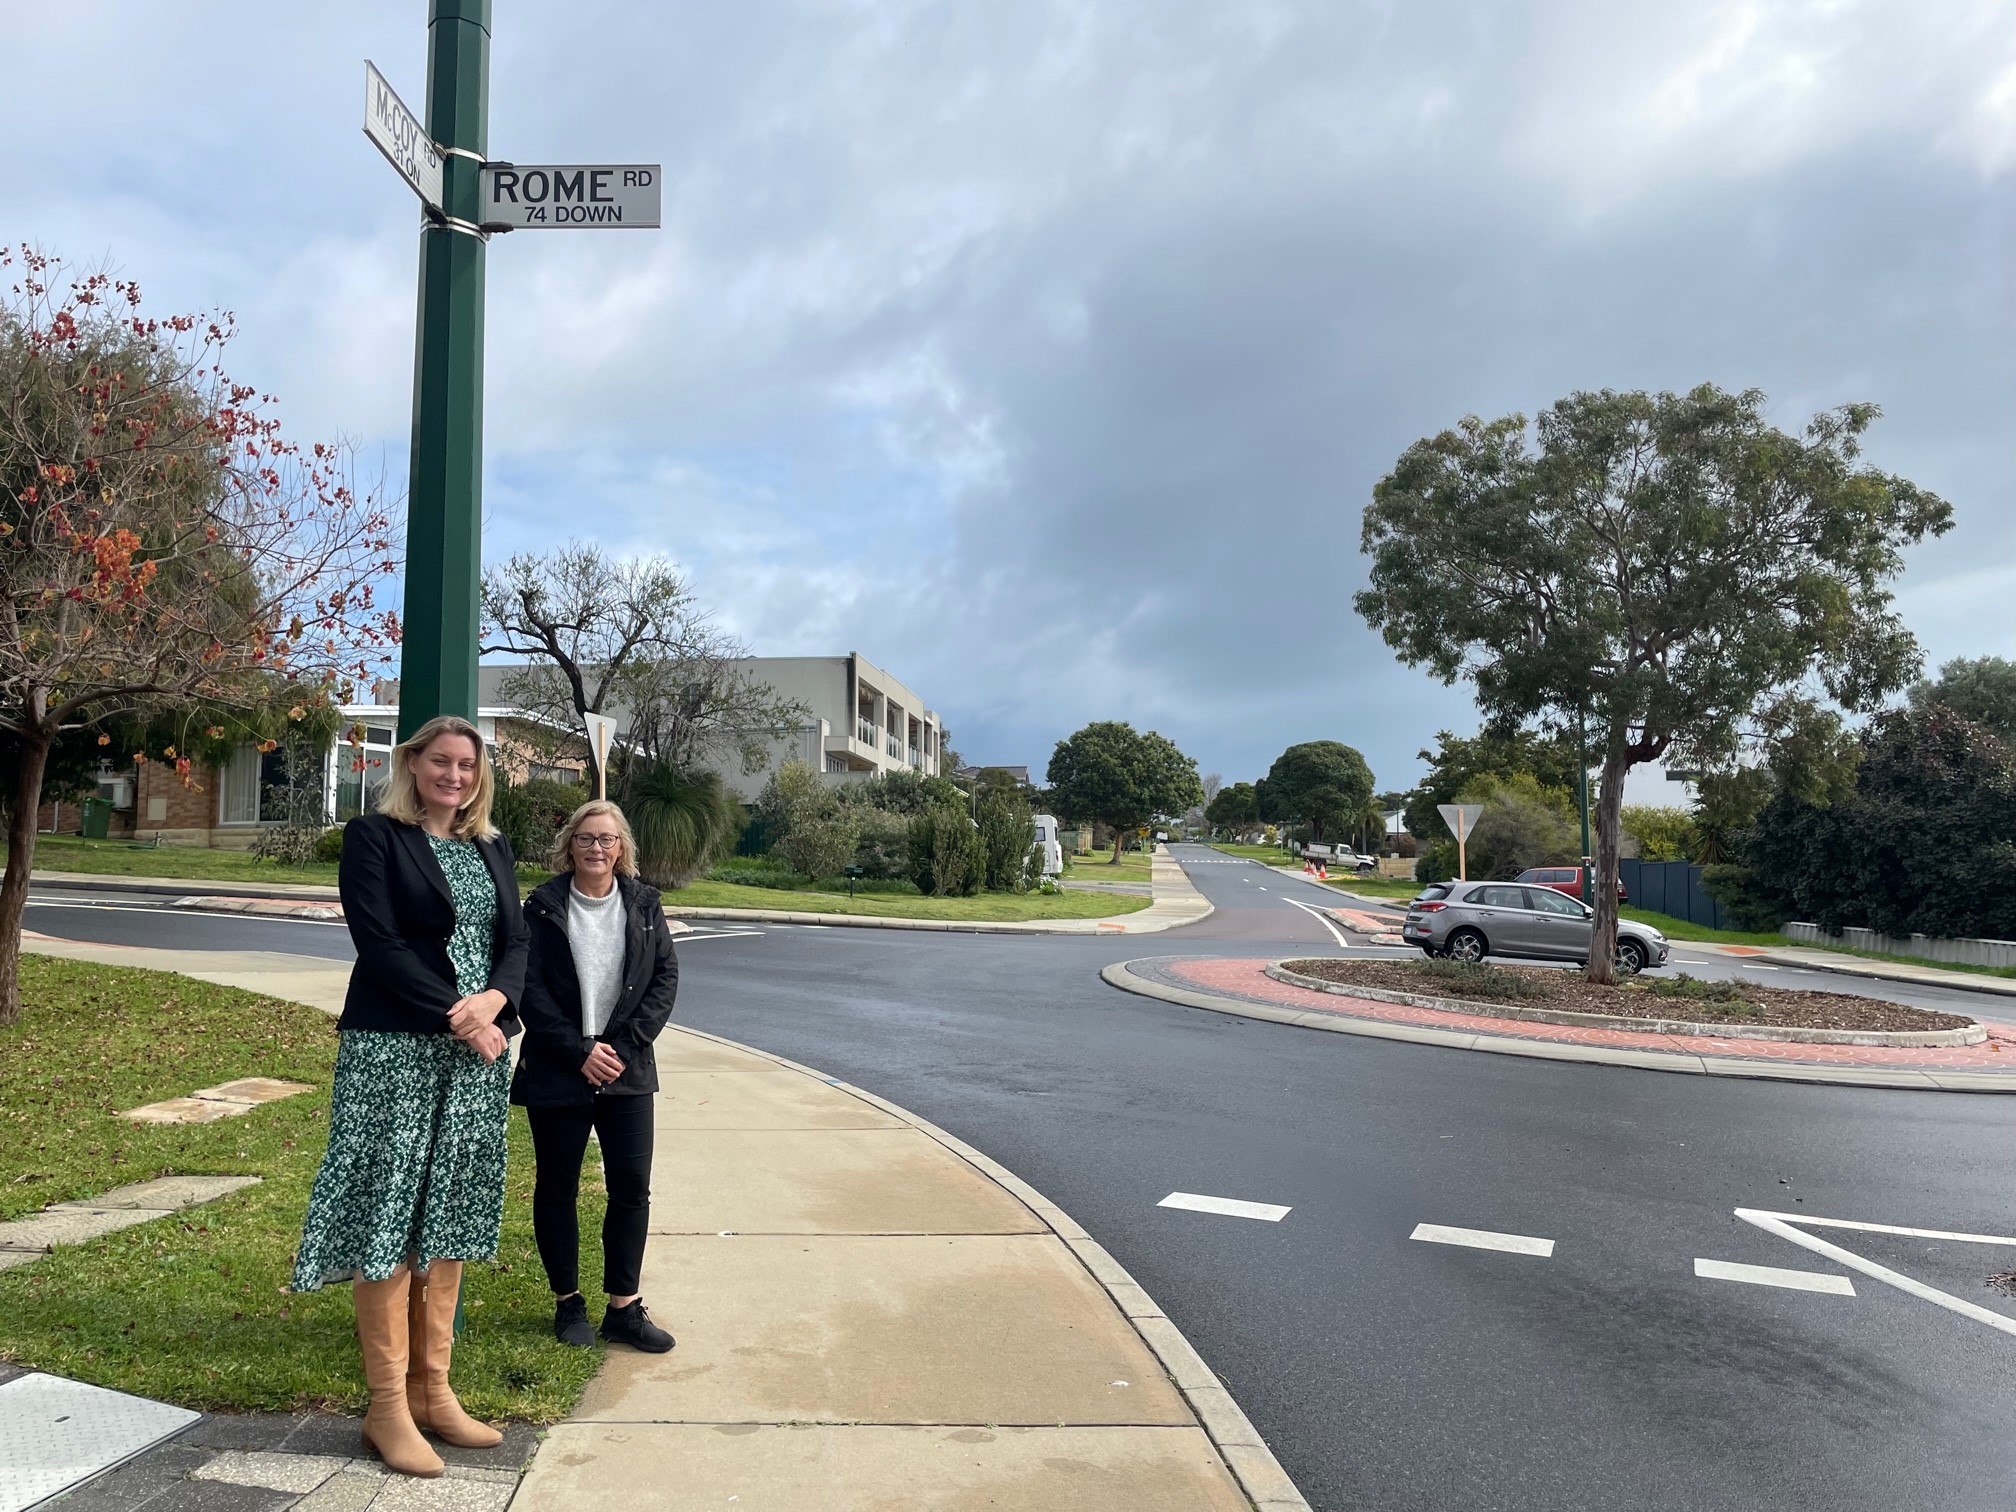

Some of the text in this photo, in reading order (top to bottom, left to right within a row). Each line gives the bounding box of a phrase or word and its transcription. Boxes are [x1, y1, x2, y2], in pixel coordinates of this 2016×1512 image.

[393, 141, 420, 187] 31 ON
[424, 142, 436, 169] RD
[493, 170, 652, 203] ROME RD
[524, 205, 622, 223] 74 DOWN
